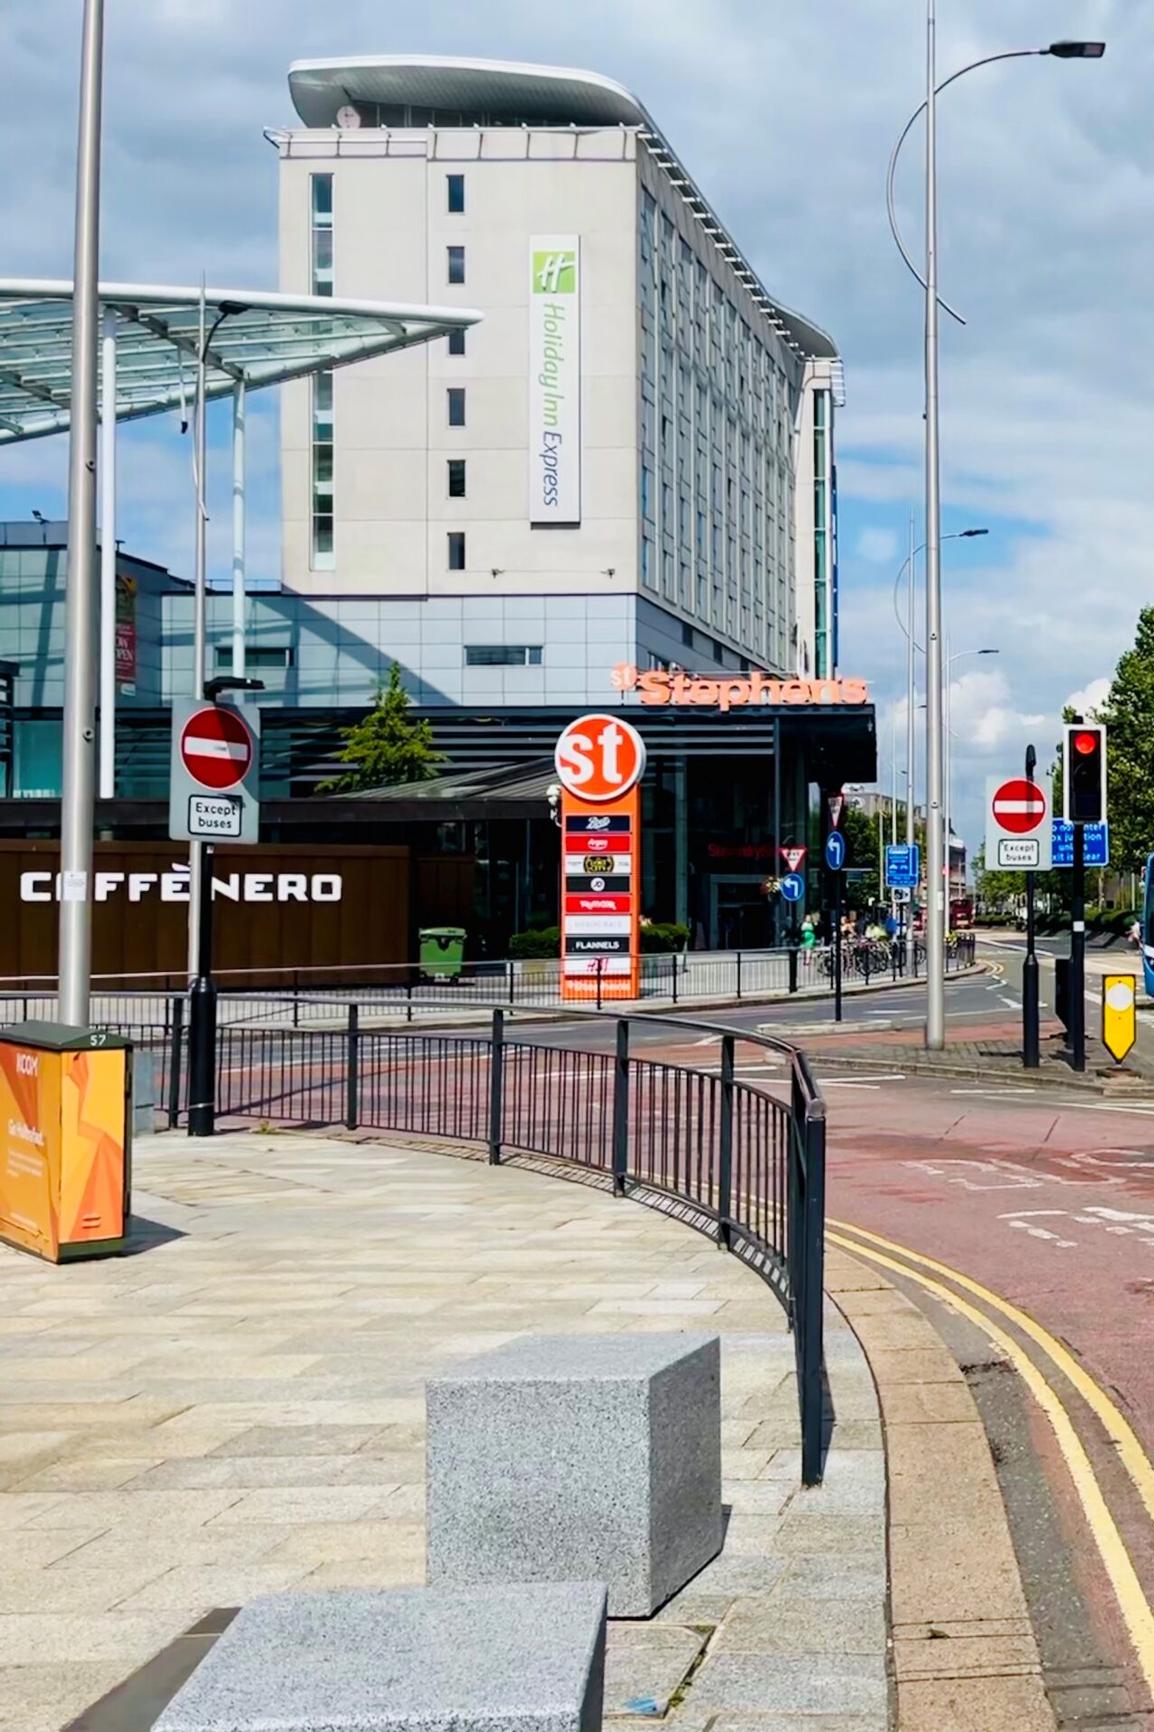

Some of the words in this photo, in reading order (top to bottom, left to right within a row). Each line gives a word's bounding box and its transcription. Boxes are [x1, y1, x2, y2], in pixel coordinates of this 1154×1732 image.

[538, 303, 564, 390] Holiday
[543, 392, 565, 427] Inn
[539, 430, 562, 507] Express
[556, 723, 623, 784] st
[195, 802, 236, 816] Except
[198, 817, 232, 829] buses
[1064, 833, 1101, 842] jution
[1003, 844, 1035, 852] Except
[1006, 853, 1032, 861] buses
[20, 861, 191, 902] CFFÈ
[211, 873, 342, 902] NERO
[575, 941, 620, 950] FLANNELS
